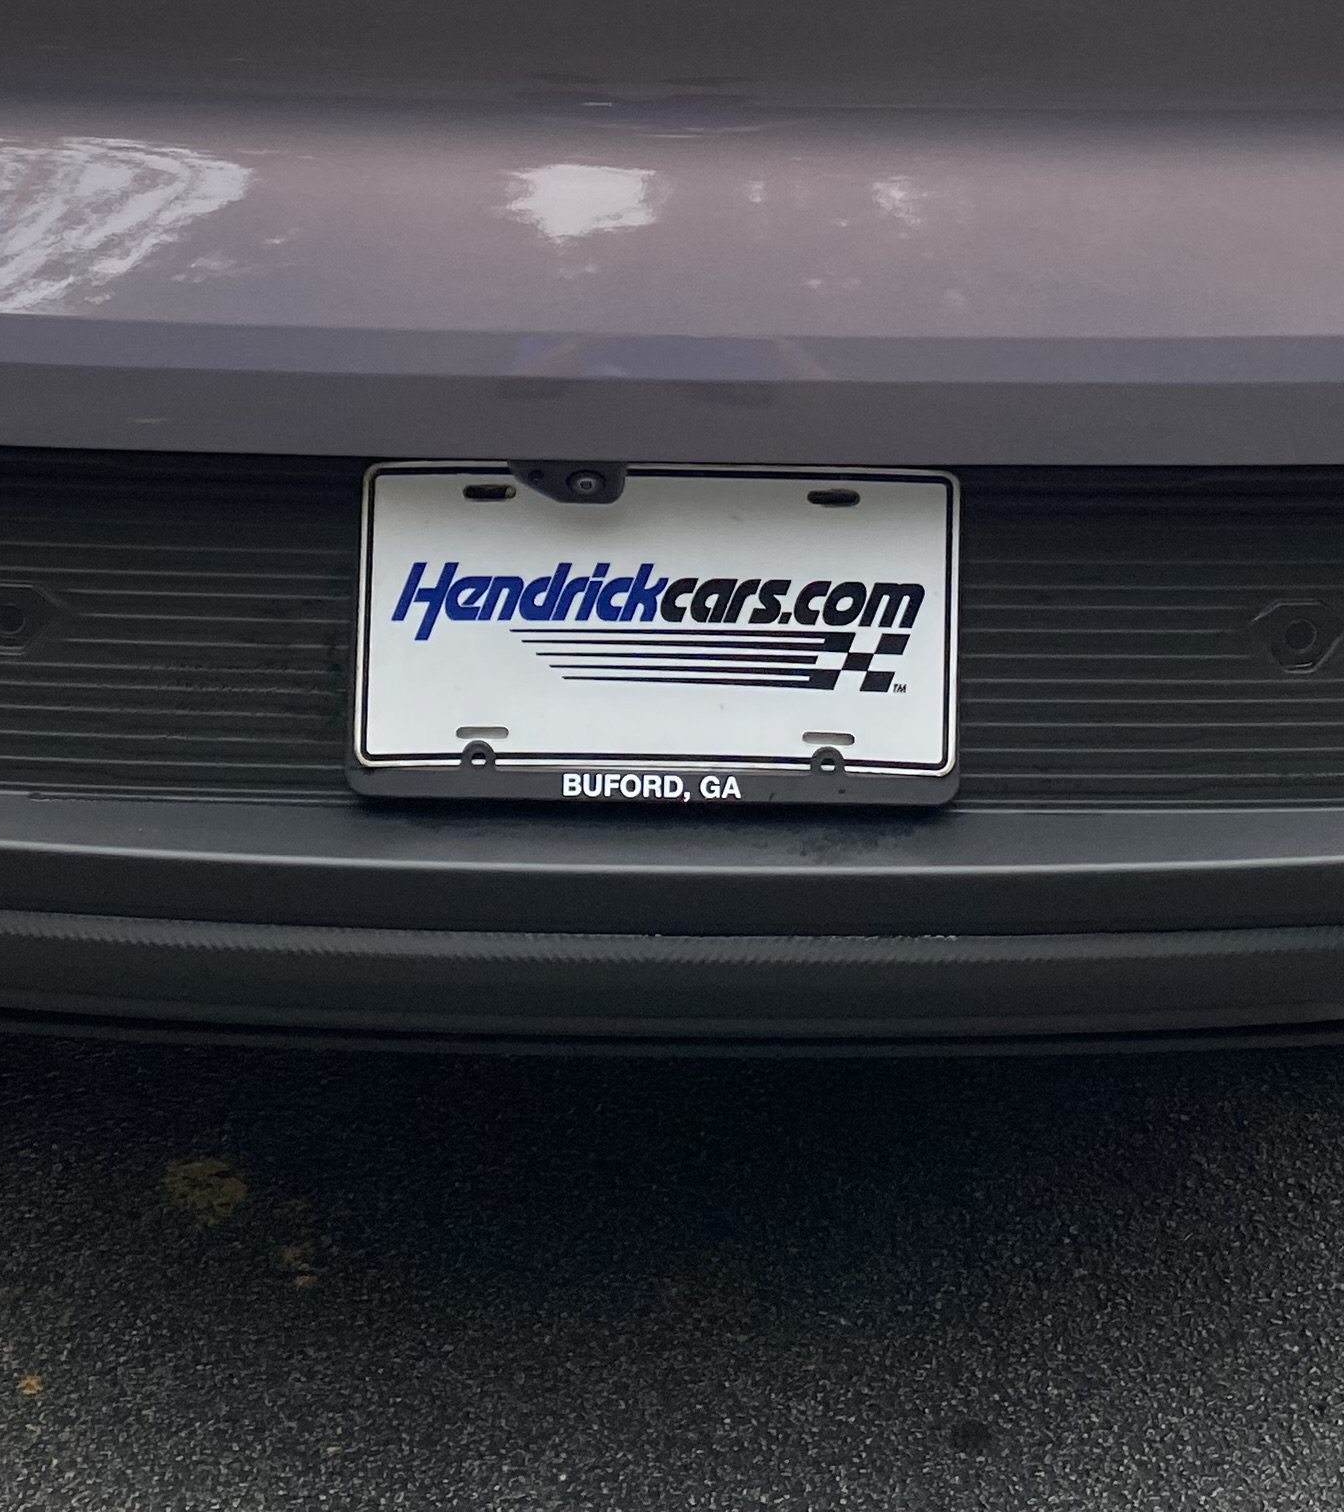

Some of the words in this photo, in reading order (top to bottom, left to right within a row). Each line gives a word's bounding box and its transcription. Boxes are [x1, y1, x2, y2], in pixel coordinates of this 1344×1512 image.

[390, 561, 926, 642] Hendrickcars.com
[892, 682, 907, 694] TM
[562, 773, 691, 803] BUFORD,
[699, 775, 742, 799] GA
